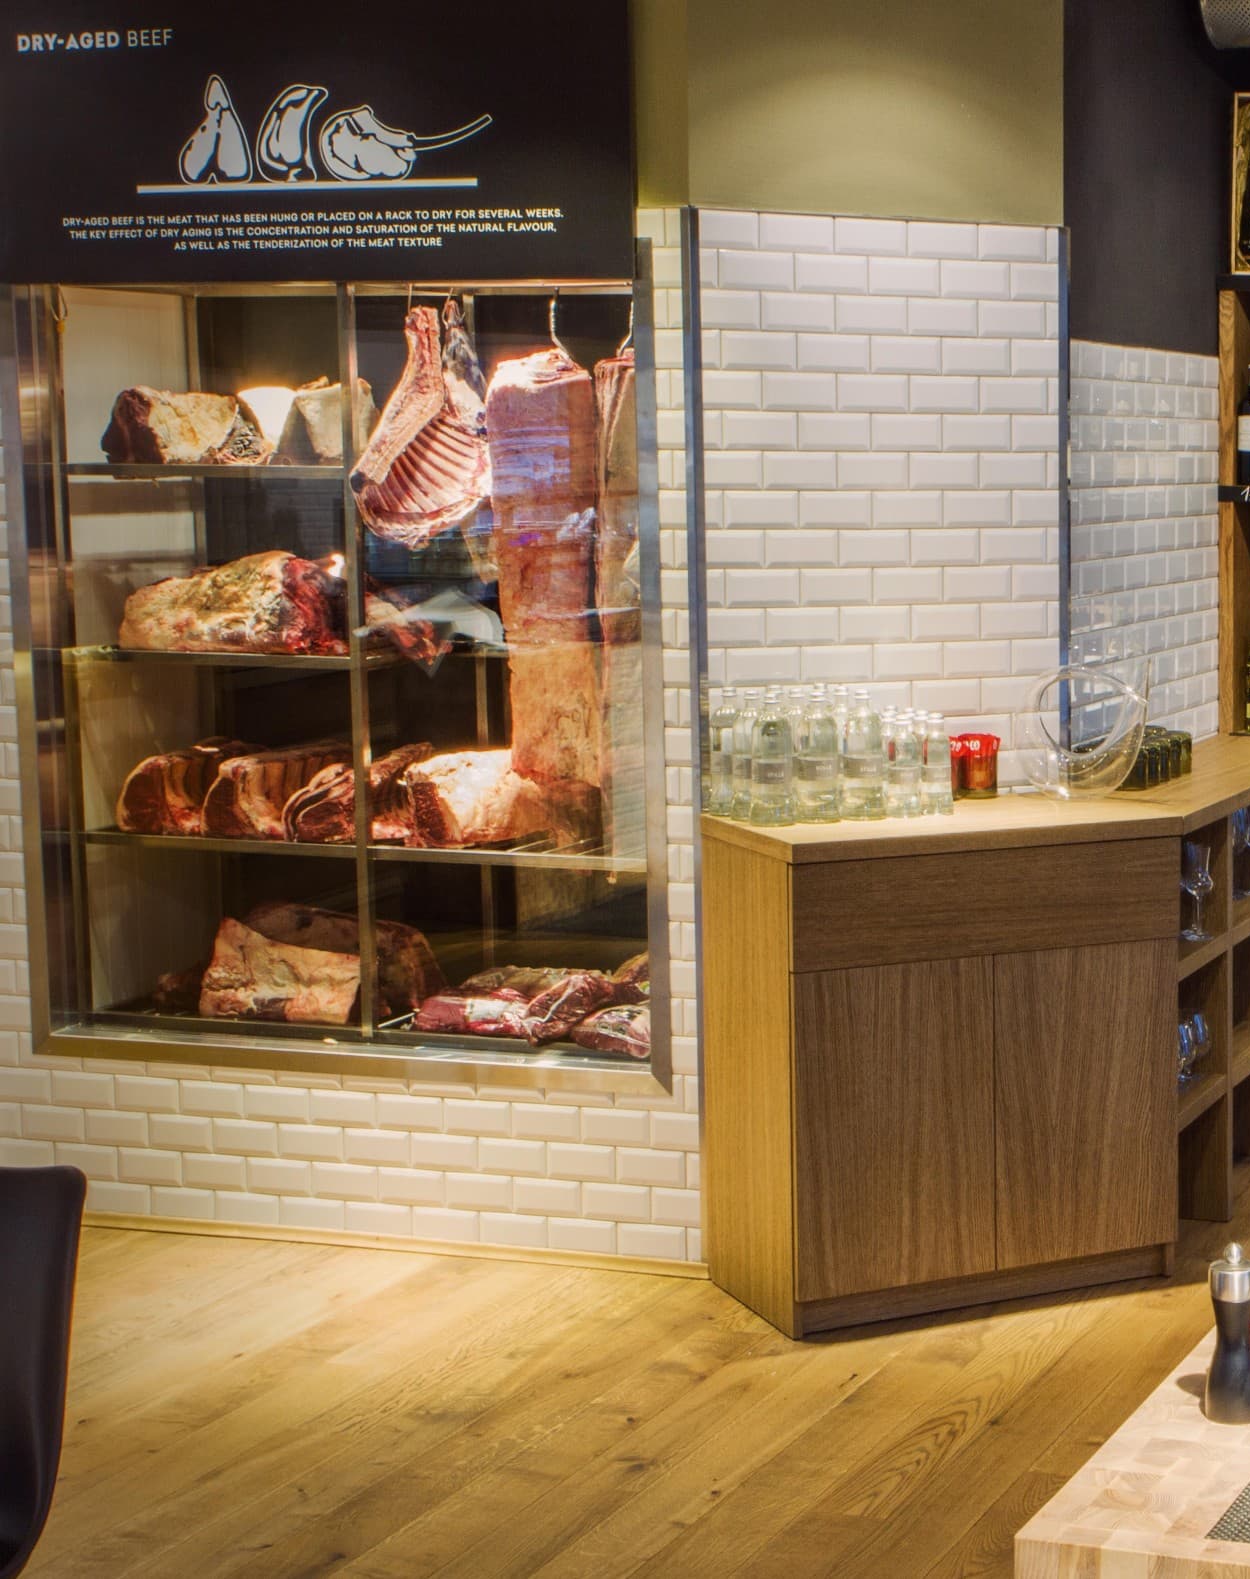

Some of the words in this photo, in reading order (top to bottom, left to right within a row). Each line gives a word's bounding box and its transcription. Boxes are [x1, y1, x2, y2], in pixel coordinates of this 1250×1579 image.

[16, 31, 121, 52] DRY-AGED
[126, 28, 174, 48] BEEF
[62, 216, 110, 228] DRY-AGED
[111, 216, 134, 227] BEEF
[135, 216, 145, 226] IS
[146, 215, 166, 226] THE
[167, 215, 193, 226] MEAT
[194, 214, 220, 225] THAT
[221, 214, 242, 225] HAS
[243, 213, 268, 224] BEEN
[269, 213, 299, 224] HUNG
[300, 212, 316, 223] OR
[316, 212, 357, 223] PLACED
[357, 211, 374, 222] ON
[375, 211, 384, 222] A
[384, 211, 413, 222] RACK
[413, 210, 430, 221] TO
[431, 210, 453, 221] DRY
[454, 210, 477, 220] FOR
[477, 209, 524, 220] SEVERAL
[524, 208, 565, 219] WEEKS.
[68, 230, 88, 240] THE
[89, 230, 107, 240] KEY
[108, 229, 143, 239] EFFECT
[144, 229, 159, 239] OF
[160, 229, 180, 238] DRY
[181, 228, 213, 238] AGING
[213, 228, 225, 237] IS
[225, 227, 245, 237] THE
[245, 226, 331, 237] CONCENTRATION
[331, 225, 354, 235] AND
[355, 224, 418, 235] SATURATION
[418, 224, 435, 234] OF
[435, 224, 457, 233] THE
[457, 223, 505, 233] NATURAL
[506, 222, 558, 232] FLAVOUR,
[173, 241, 187, 250] AS
[188, 240, 215, 250] WELL
[216, 240, 231, 250] AS
[231, 240, 251, 250] THE
[252, 238, 329, 249] TENDERIZATION
[330, 238, 345, 248] OF
[345, 238, 367, 248] THE
[367, 237, 396, 247] MEAT
[396, 236, 443, 247] TEXTURE
